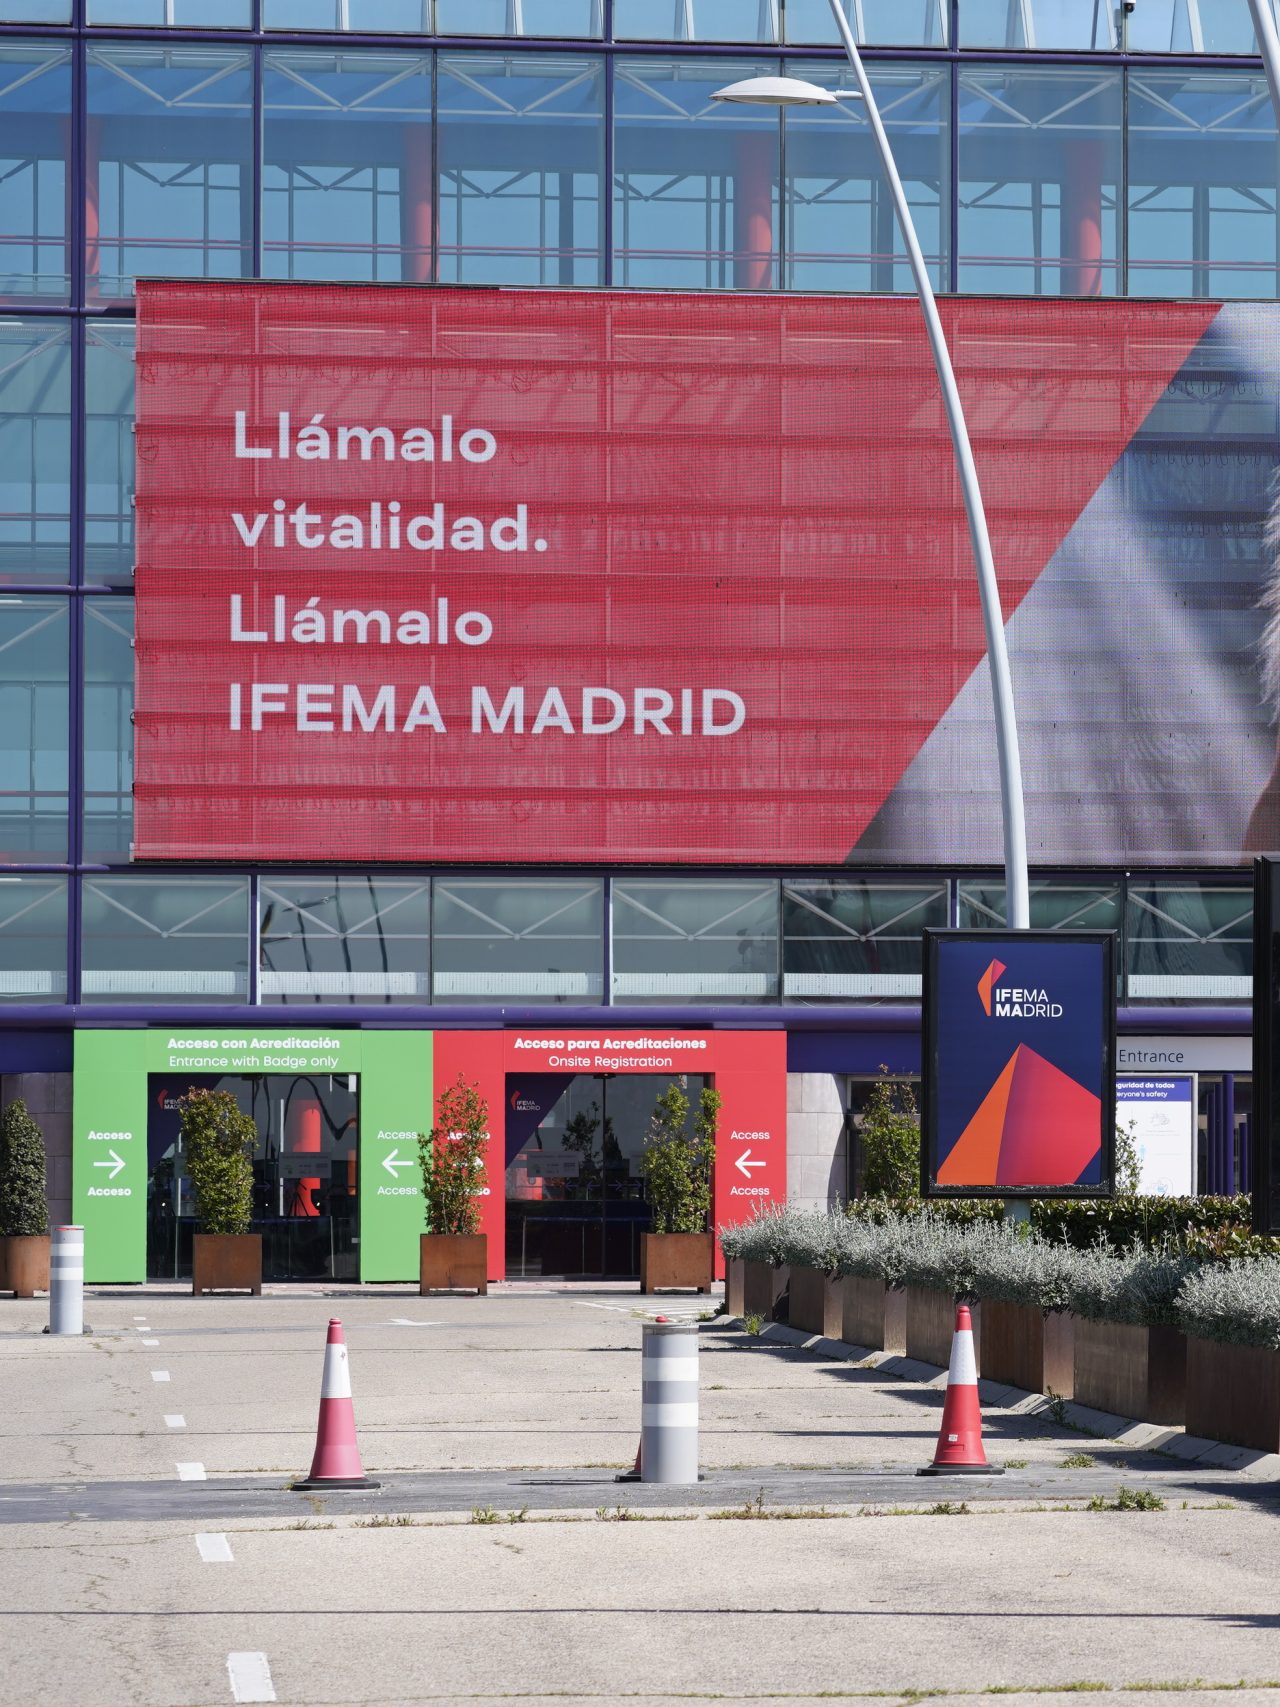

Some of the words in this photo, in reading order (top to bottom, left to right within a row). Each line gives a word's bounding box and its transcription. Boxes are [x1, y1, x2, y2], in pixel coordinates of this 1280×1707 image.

[234, 410, 498, 463] Llámalo
[231, 498, 549, 552] vitalidad.
[230, 593, 493, 646] Llámalo
[230, 682, 447, 734] IFEMA
[471, 686, 746, 737] MADRID
[995, 988, 1049, 1003] IFEMA
[995, 1003, 1063, 1018] MADRID
[167, 1038, 219, 1049] Acceso
[221, 1039, 247, 1049] con
[250, 1037, 340, 1049] Acreditación
[514, 1038, 565, 1049] Acceso
[567, 1039, 600, 1052] para
[602, 1037, 707, 1049] Acreditaciones
[169, 1056, 228, 1067] Entrance
[232, 1055, 260, 1067] with
[263, 1055, 307, 1070] Badge
[310, 1055, 339, 1070] only
[548, 1055, 591, 1067] Onsite
[594, 1055, 672, 1069] Registration
[1119, 1049, 1184, 1063] Entrance
[1146, 1091, 1168, 1099] safety
[87, 1130, 132, 1140] Acceso
[377, 1130, 417, 1140] Access
[730, 1130, 770, 1140] Access
[87, 1186, 132, 1197] Acceso
[377, 1185, 418, 1196] Access
[730, 1185, 770, 1196] Access
